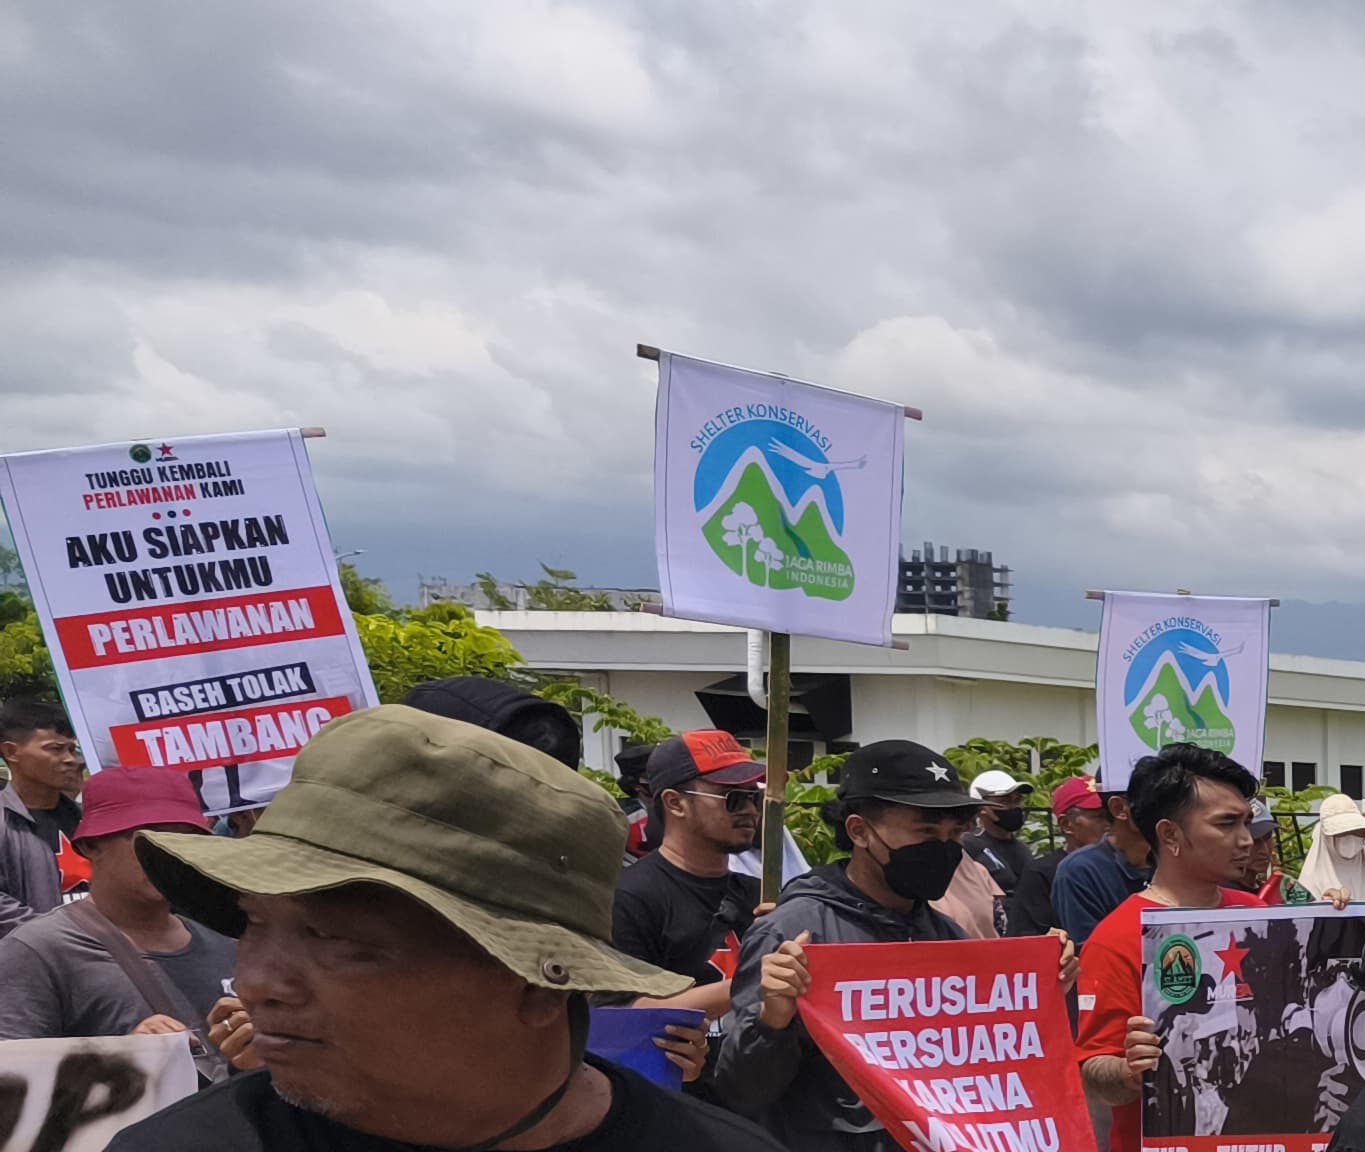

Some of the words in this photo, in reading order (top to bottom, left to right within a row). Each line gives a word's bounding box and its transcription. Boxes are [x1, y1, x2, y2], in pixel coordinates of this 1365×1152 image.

[690, 407, 745, 453] SHELTER
[747, 403, 832, 453] KONSERVASI
[82, 484, 197, 511] PERLAWANAN
[199, 479, 245, 499] KAMI
[85, 467, 154, 490] TUNGGU
[157, 460, 231, 483] KEMBALI
[65, 530, 138, 569] AKU
[147, 514, 290, 559] SIAPKAN
[104, 555, 273, 604] UNTUKMU
[786, 571, 849, 589] INDONESIA
[816, 560, 853, 577] RIMBA
[87, 598, 315, 656] PERLAWANAN
[1123, 623, 1163, 662] SHELTER
[1163, 616, 1222, 646] KONSERVASI
[137, 681, 227, 719] BASEH
[232, 666, 308, 701] TOLAK
[834, 972, 1038, 1021] TERUSLAH
[843, 1021, 1044, 1070] BERSUARA
